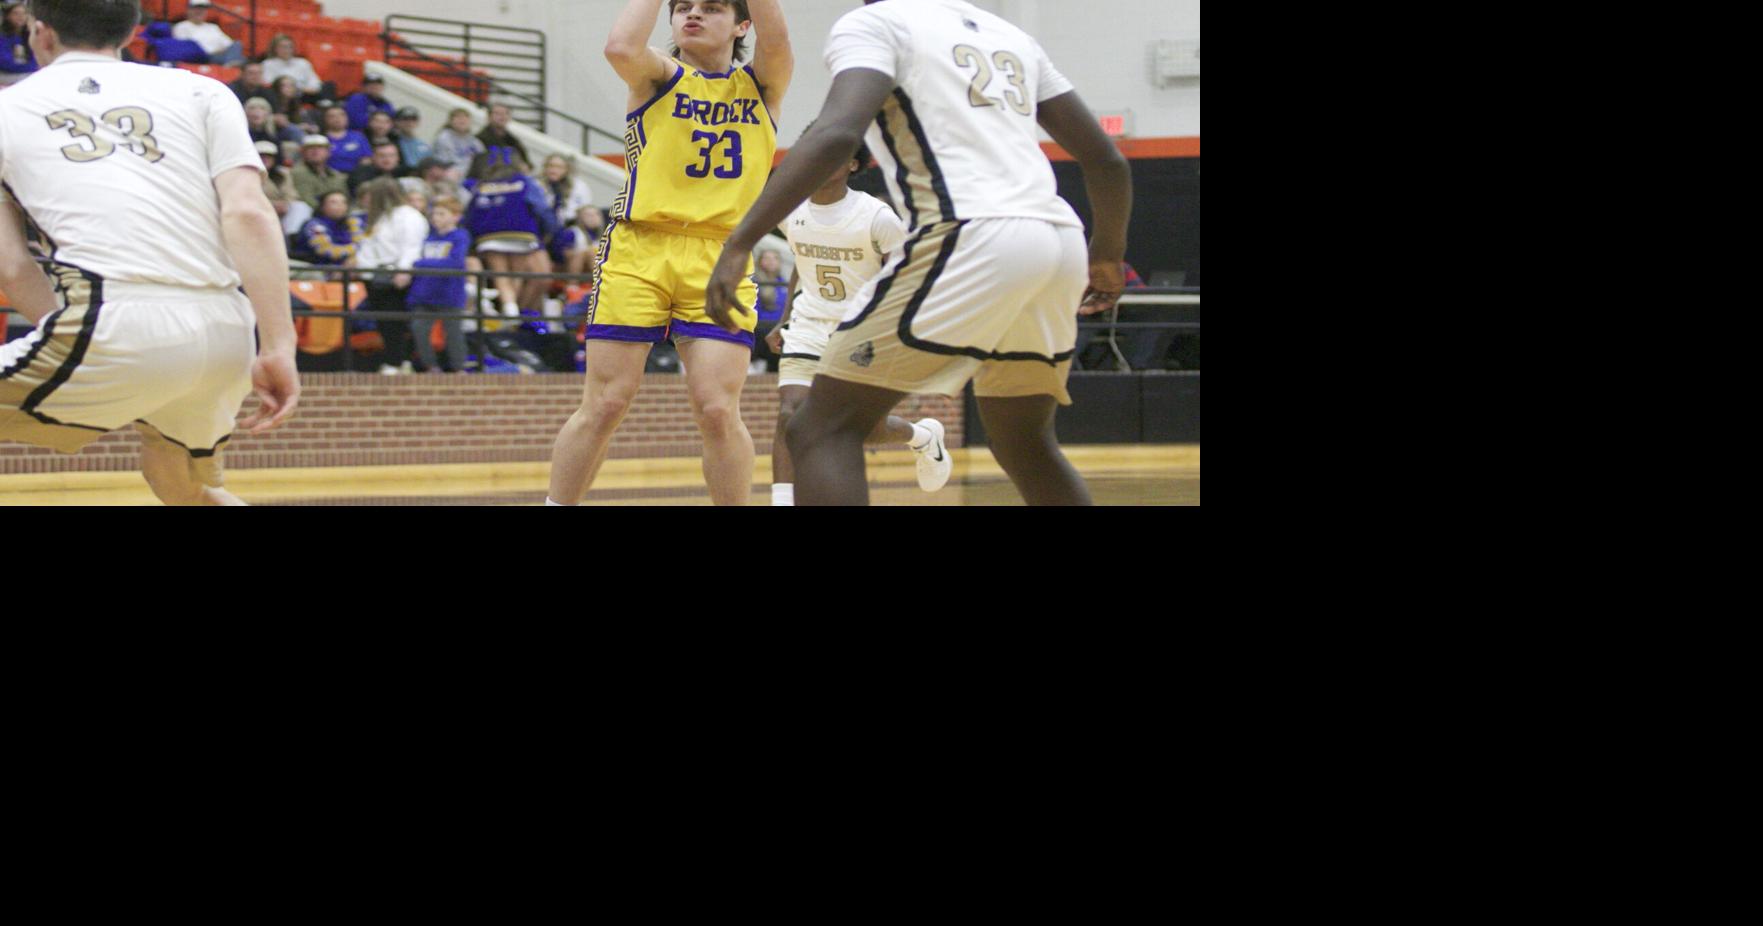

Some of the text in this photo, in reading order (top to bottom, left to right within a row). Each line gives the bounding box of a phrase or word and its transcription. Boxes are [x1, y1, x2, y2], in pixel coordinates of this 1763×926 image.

[953, 44, 1032, 116] 23
[44, 106, 165, 163] 33
[672, 93, 760, 126] BROCK
[685, 129, 743, 179] 33
[815, 264, 847, 302] 5
